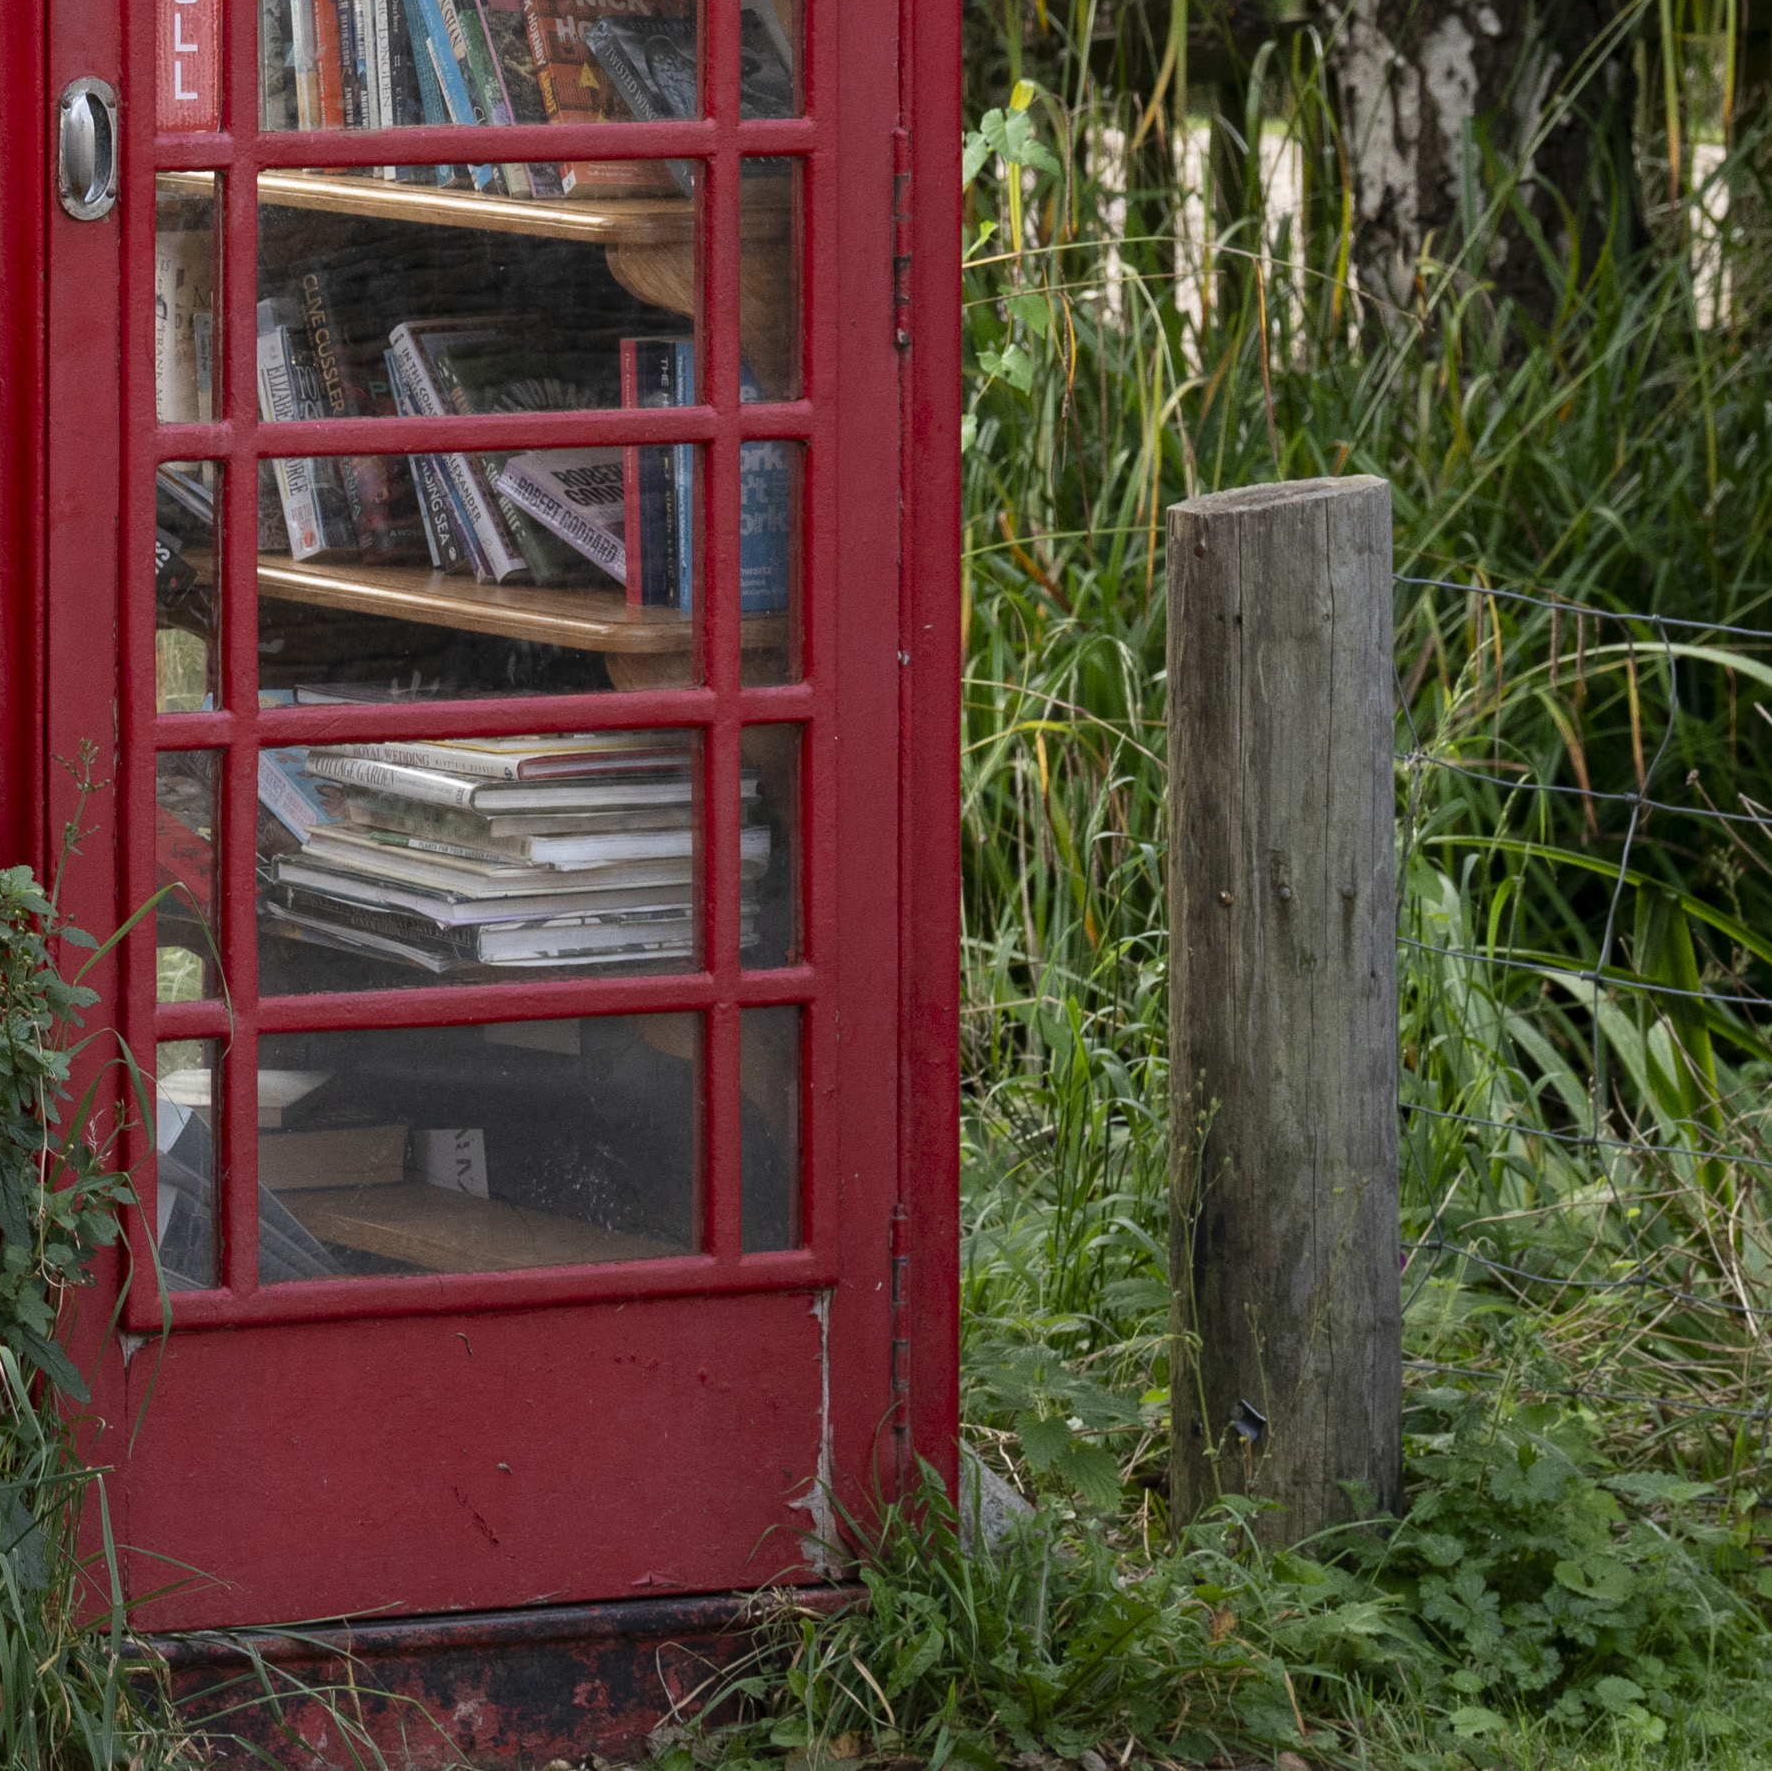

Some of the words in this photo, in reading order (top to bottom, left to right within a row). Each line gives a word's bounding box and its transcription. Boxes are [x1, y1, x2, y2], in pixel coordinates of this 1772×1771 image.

[527, 13, 547, 66] HORNBY
[379, 26, 390, 108] LONGDEN
[539, 70, 556, 112] ABOUT
[606, 45, 636, 92] TWISTED
[303, 273, 327, 328] CLIVE
[315, 328, 345, 415] CUSSLER
[434, 513, 451, 546] SEA
[559, 510, 618, 564] GODDARD
[353, 746, 383, 761] ROYAL
[384, 748, 430, 767] WEDDING
